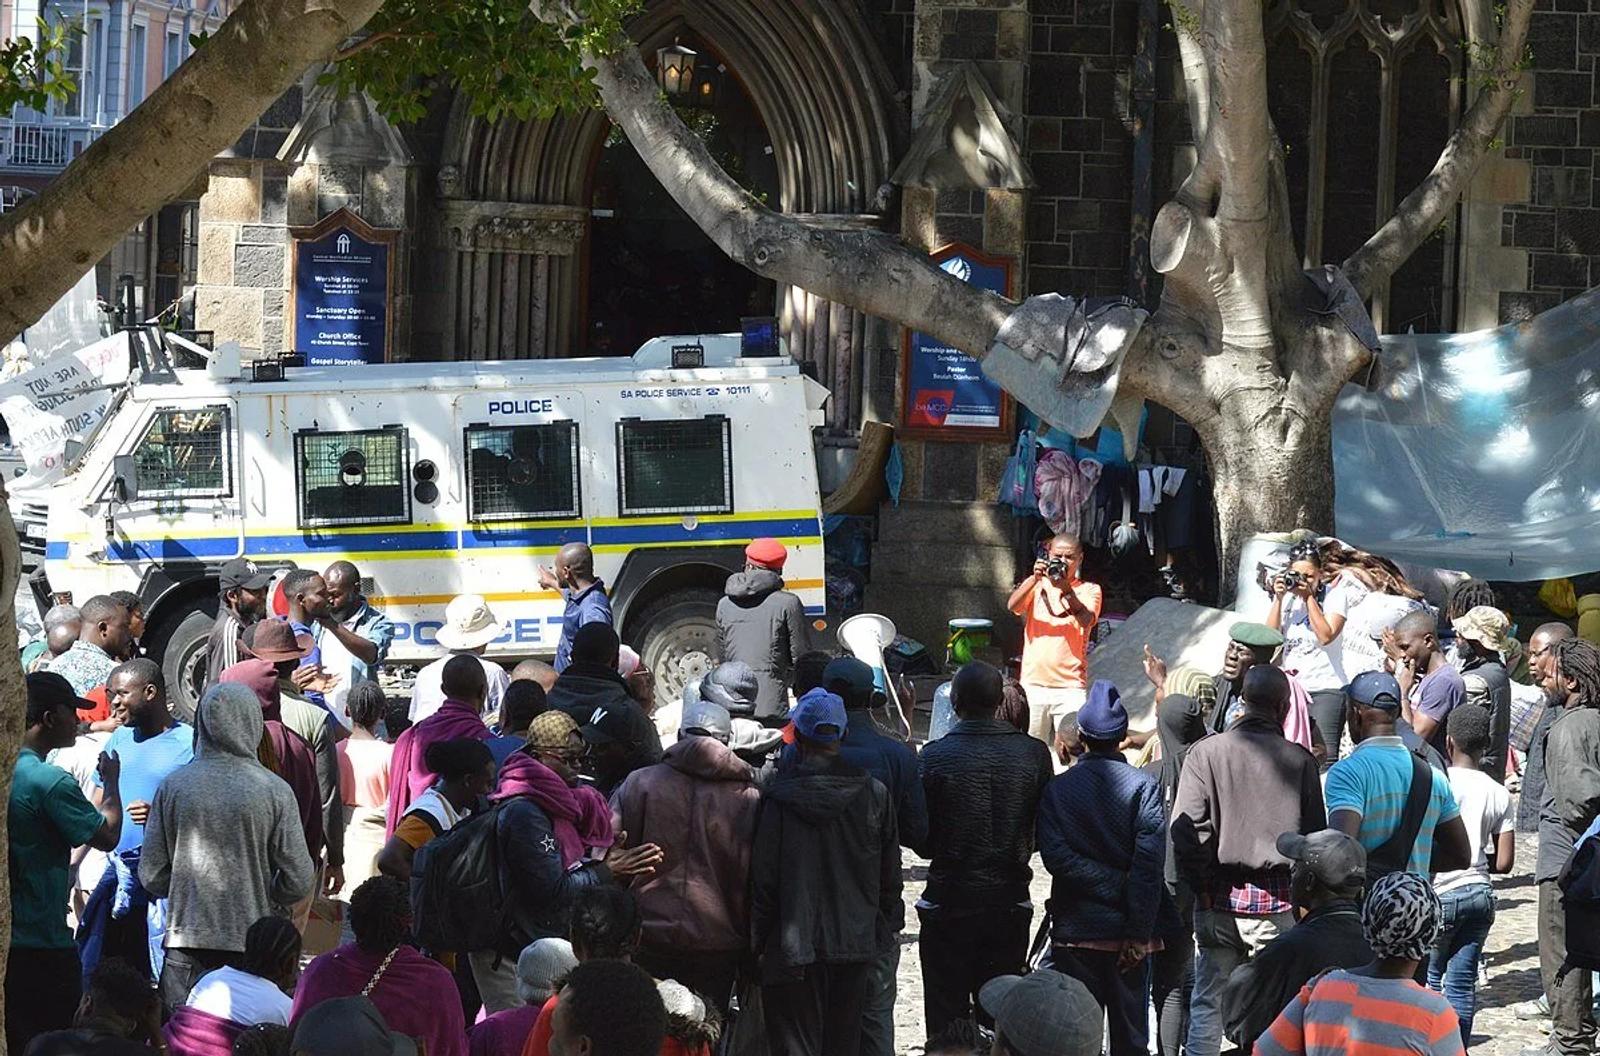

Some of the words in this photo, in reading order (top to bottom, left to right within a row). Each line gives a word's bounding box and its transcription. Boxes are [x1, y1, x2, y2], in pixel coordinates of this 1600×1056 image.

[314, 275, 341, 283] Worship
[316, 306, 347, 314] Sanctuary
[348, 307, 366, 315] Open
[920, 346, 945, 354] Worship
[310, 357, 333, 366] Gospel
[620, 390, 633, 398] SA
[635, 389, 664, 398] POLICE
[666, 388, 701, 397] SERVICE
[726, 386, 751, 395] 10111
[489, 399, 553, 415] POLICE
